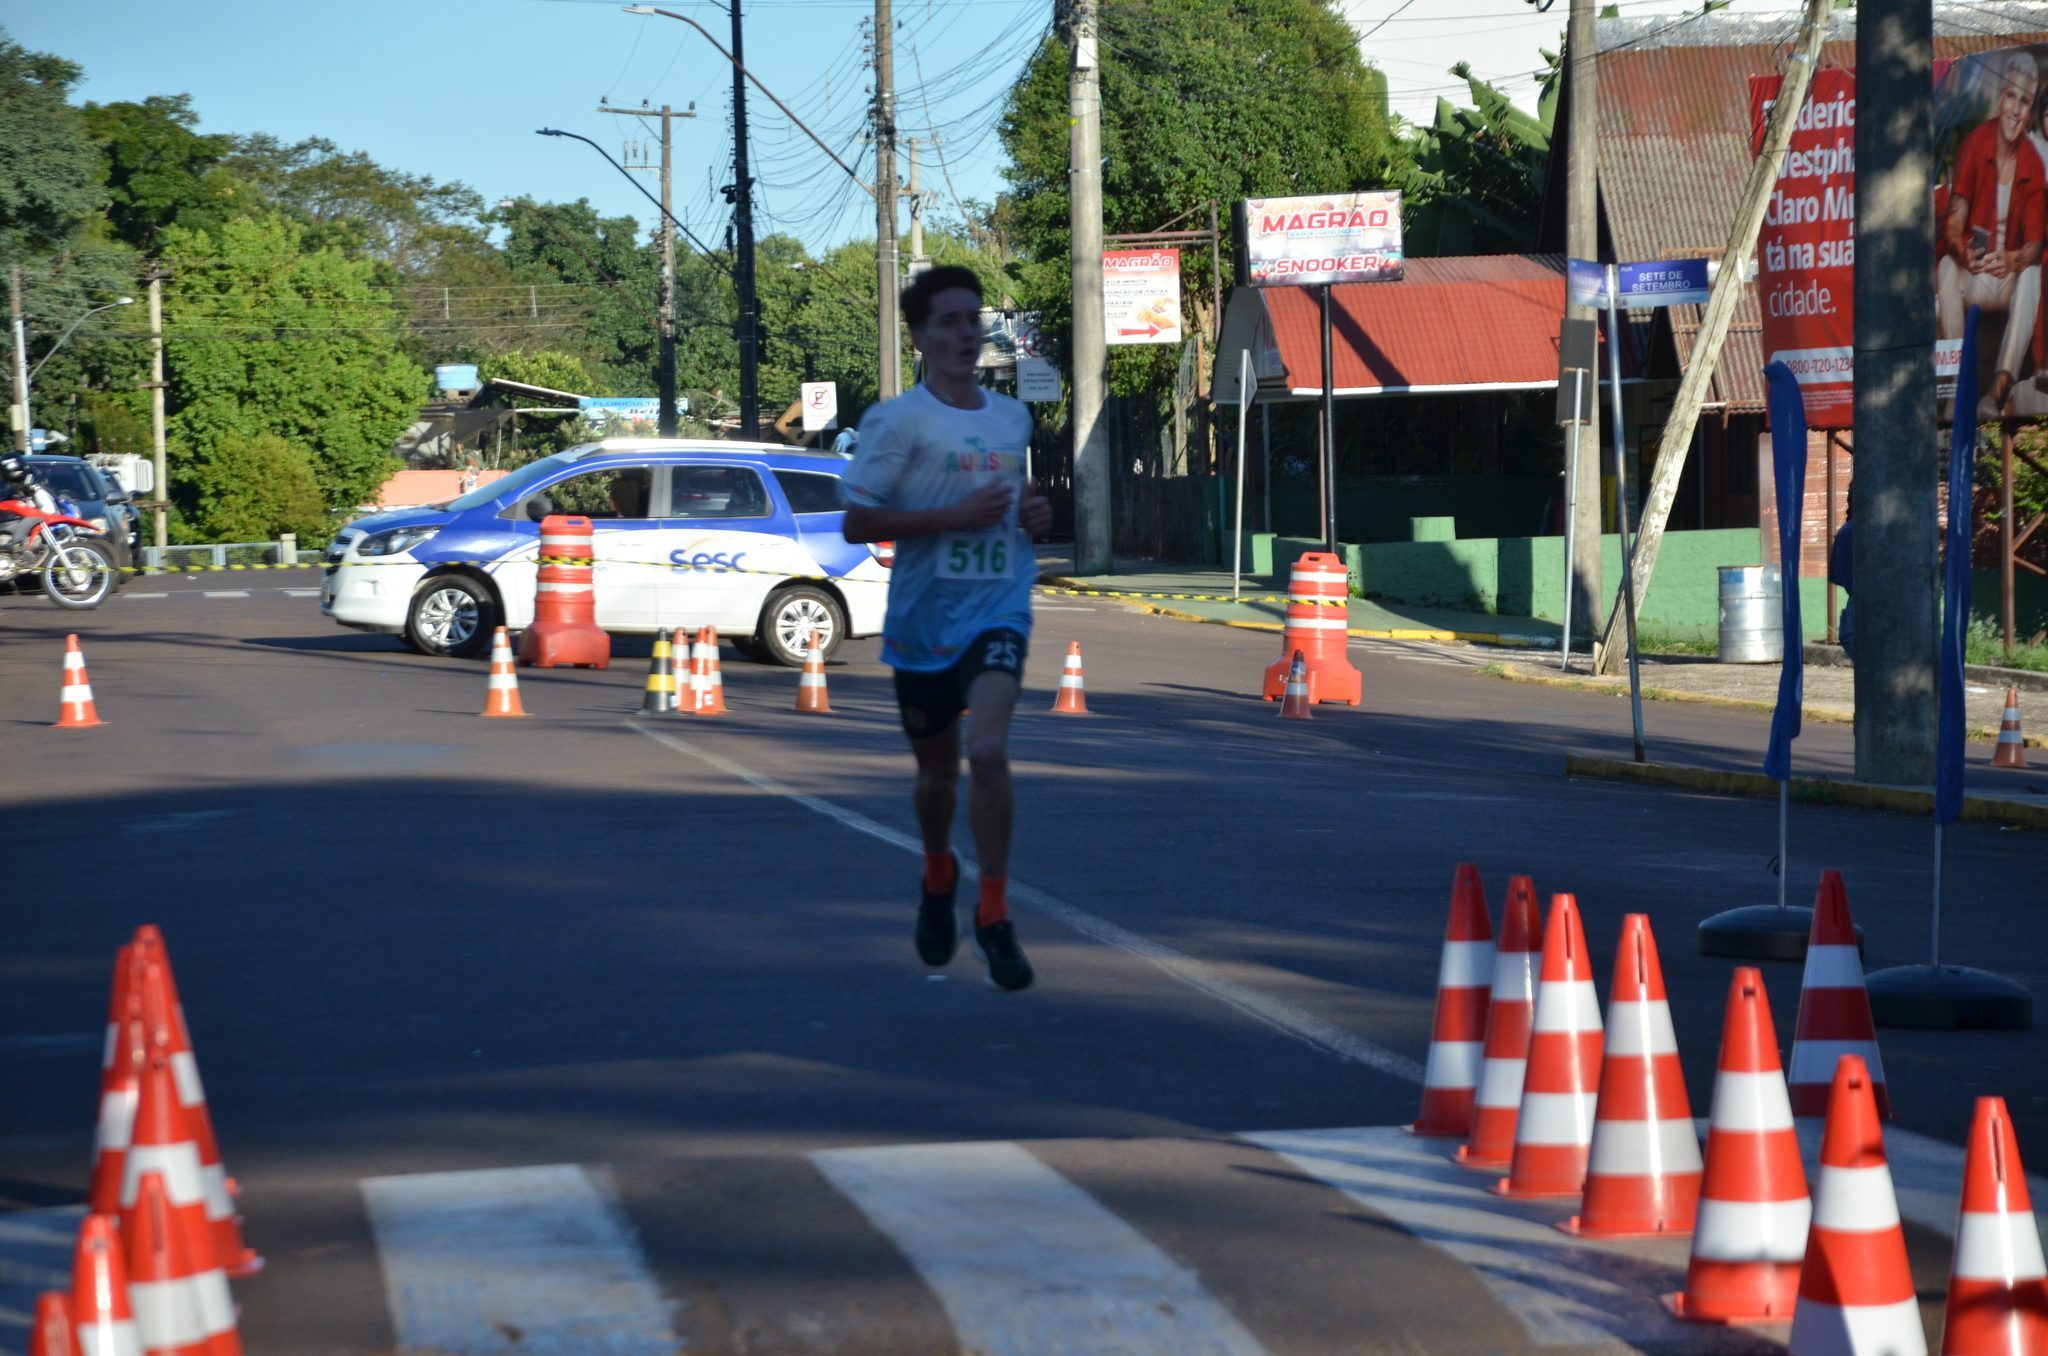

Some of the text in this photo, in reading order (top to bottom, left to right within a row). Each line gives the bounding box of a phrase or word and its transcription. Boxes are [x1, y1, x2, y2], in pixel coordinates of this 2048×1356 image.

[1262, 204, 1389, 232] MAGRÃO
[1765, 190, 1819, 226] Claro
[1104, 253, 1173, 268] MAGRÃO
[1276, 256, 1377, 274] SNOOKER
[1766, 235, 1786, 271] tá
[1788, 242, 1815, 270] na
[1632, 280, 1691, 293] SETEMBRO
[1639, 270, 1683, 282] SETE DE
[1770, 279, 1836, 317] cidade.
[949, 539, 1008, 574] 516
